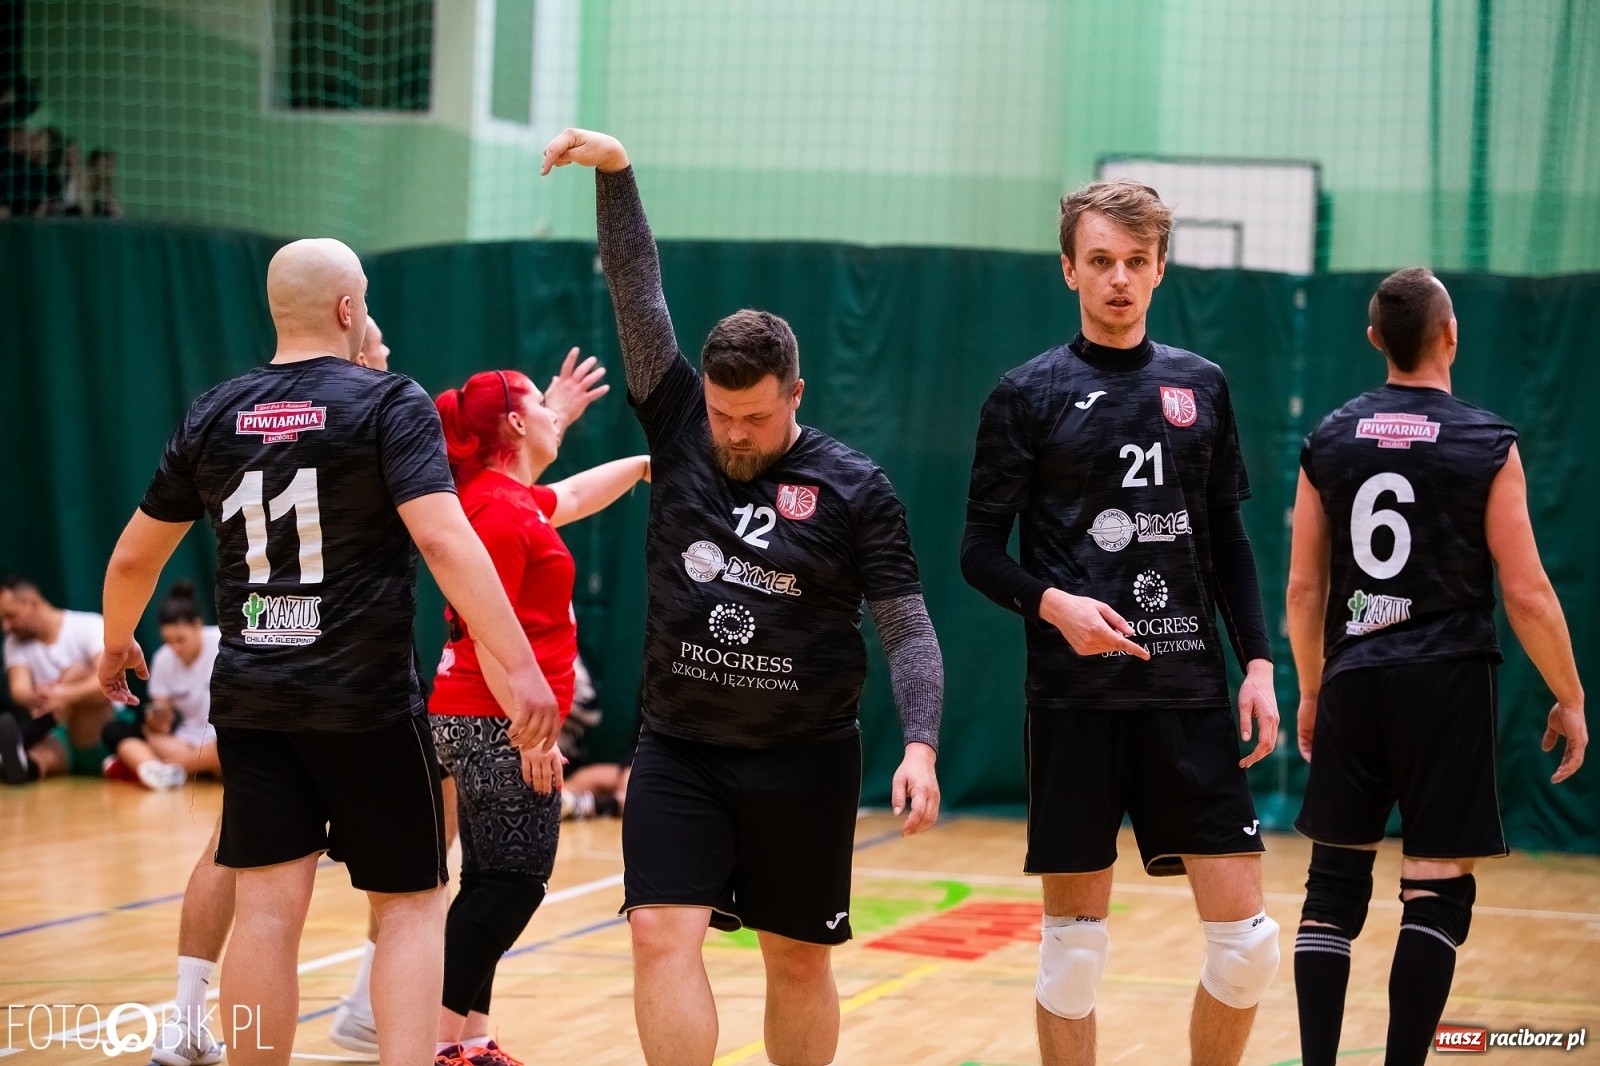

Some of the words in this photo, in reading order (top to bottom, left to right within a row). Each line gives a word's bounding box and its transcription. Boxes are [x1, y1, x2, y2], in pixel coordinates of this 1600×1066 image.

[243, 413, 318, 428] PIWIARNIA
[1362, 423, 1431, 436] PIWIARNIA
[1119, 442, 1163, 488] 21
[222, 468, 324, 584] 11
[732, 503, 777, 549] 12
[1350, 472, 1415, 580] 6
[725, 556, 801, 596] DYMEL
[265, 595, 322, 629] KAKTUS
[680, 641, 793, 673] PROGRESS
[1152, 639, 1206, 655] JĘZYKOWA
[671, 661, 719, 683] SZKOŁA
[721, 673, 799, 691] JĘZYKOWA
